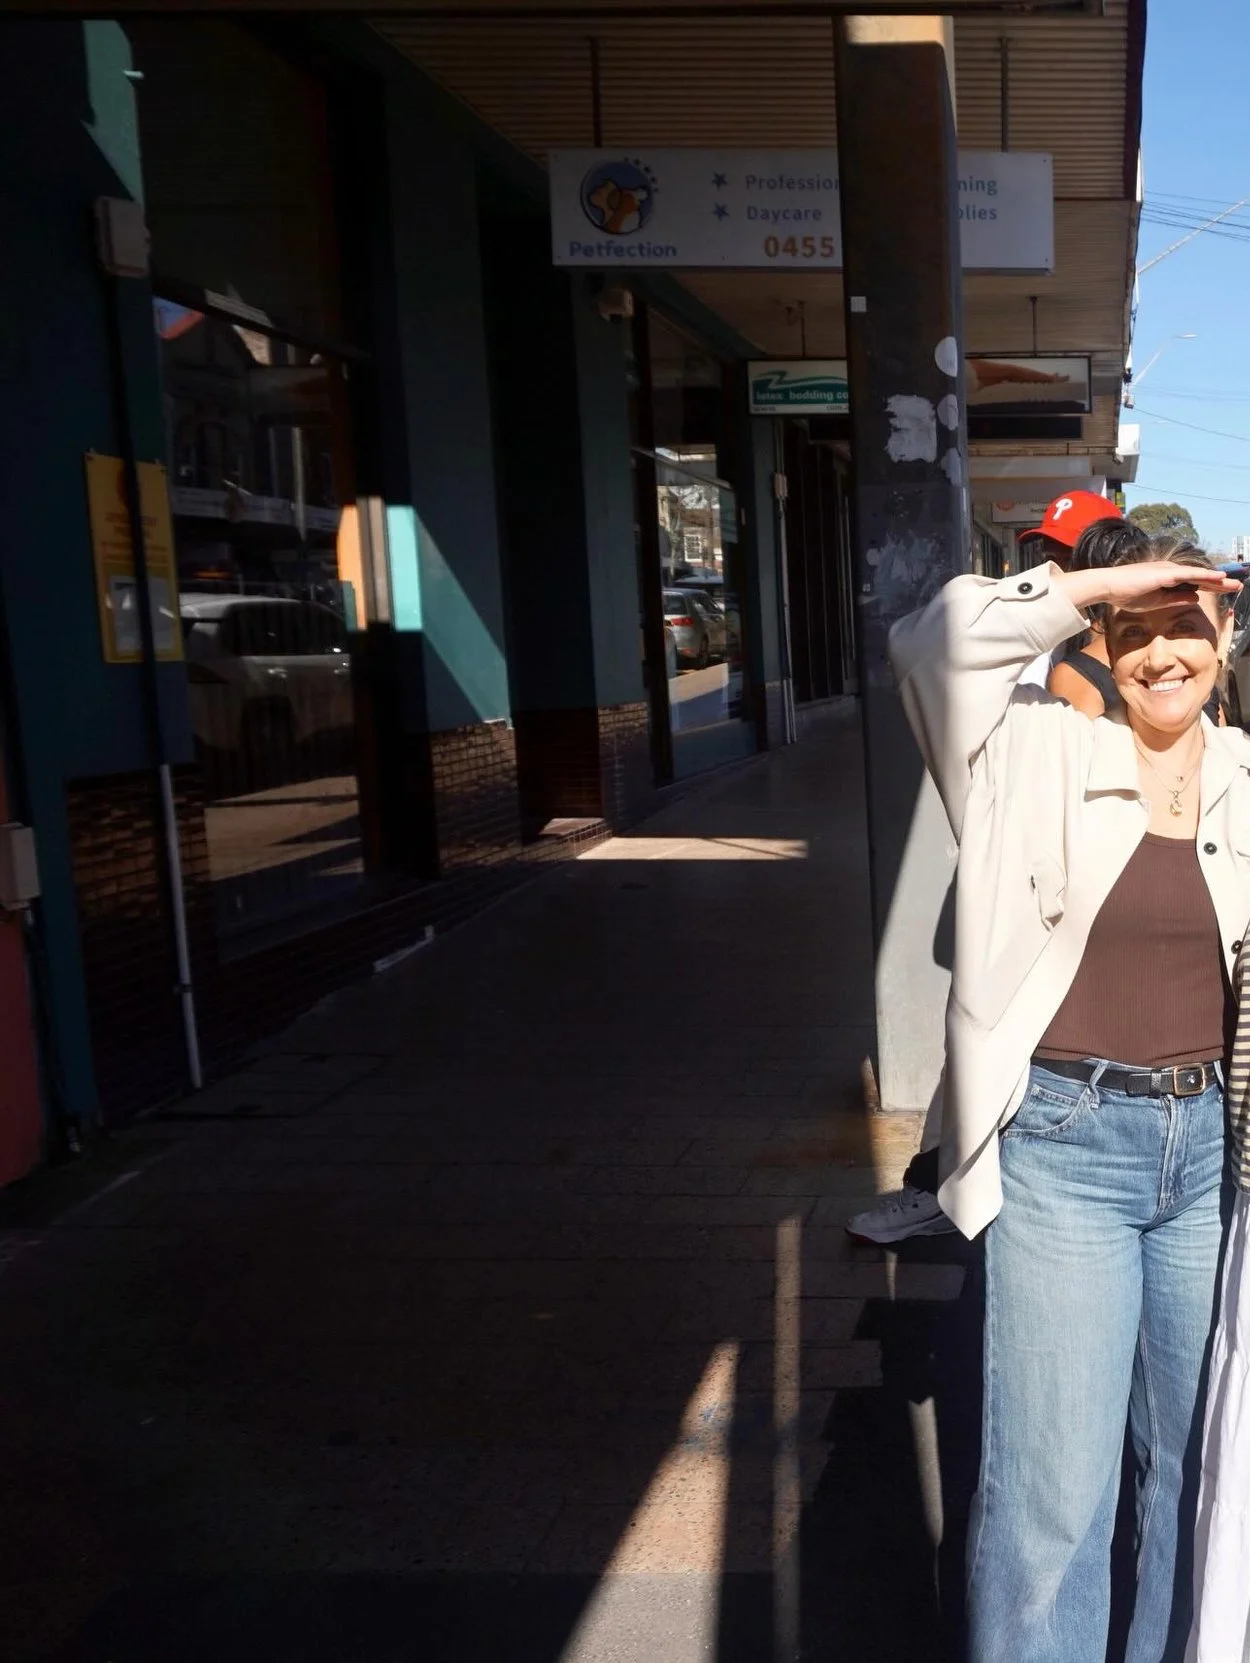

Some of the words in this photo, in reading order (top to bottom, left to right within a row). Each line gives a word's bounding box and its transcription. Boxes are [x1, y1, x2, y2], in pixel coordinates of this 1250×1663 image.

[746, 205, 822, 223] Daycare
[569, 240, 678, 258] Petfection
[763, 235, 835, 259] 0455
[789, 390, 833, 402] bedding
[1053, 498, 1073, 520] P
